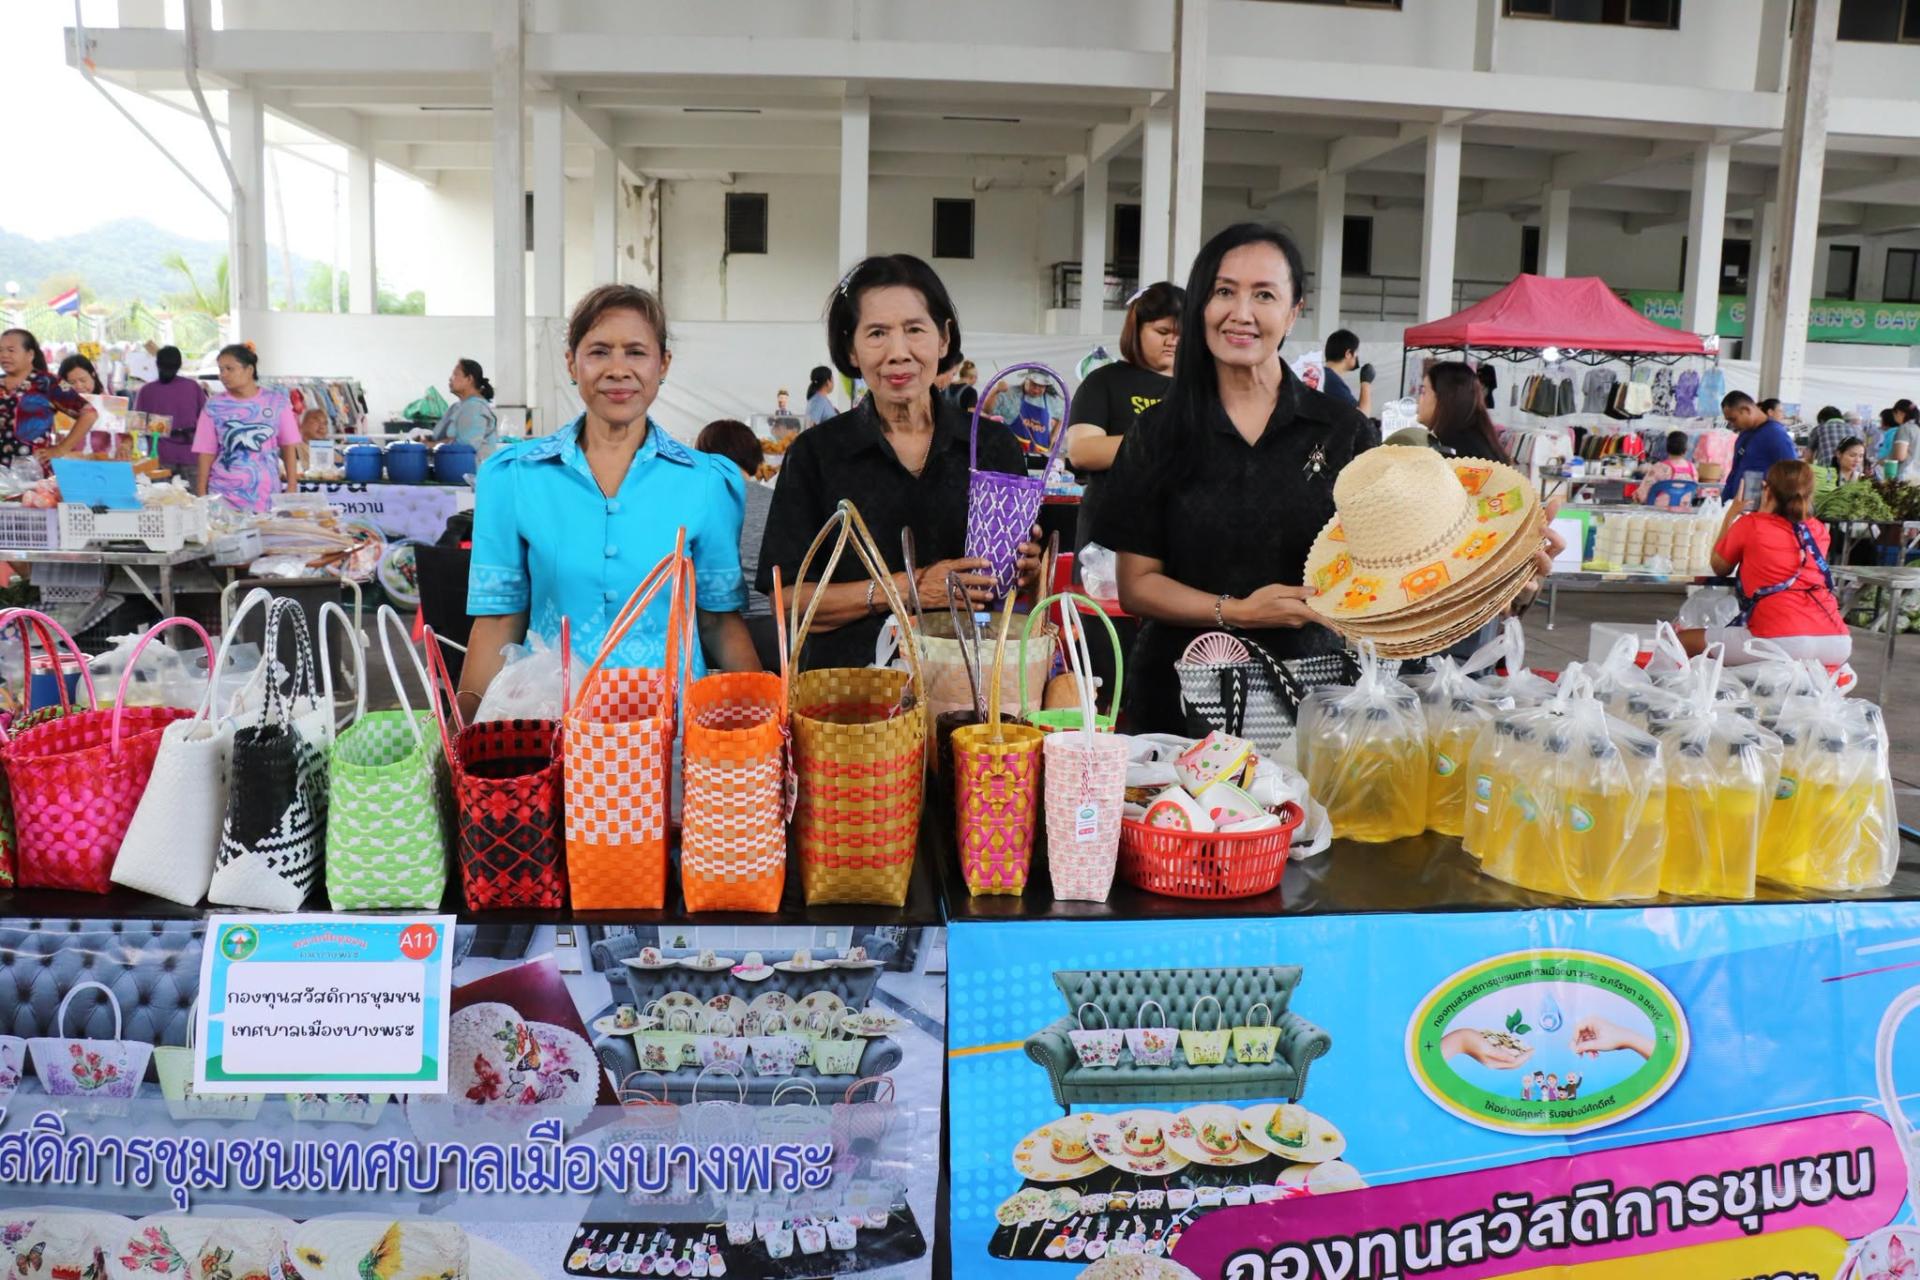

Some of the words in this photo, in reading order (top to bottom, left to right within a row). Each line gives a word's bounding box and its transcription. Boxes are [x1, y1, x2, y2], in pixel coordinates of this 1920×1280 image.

[1875, 309, 1920, 330] DAY
[400, 932, 433, 948] A11
[227, 987, 421, 1009] กองทุนสวัสดิการชุมชน
[231, 1019, 415, 1038] เทศบาลเมืองบางพระ
[0, 1108, 832, 1212] สดิการชุมชนเทศบาลเมืองบางพระ
